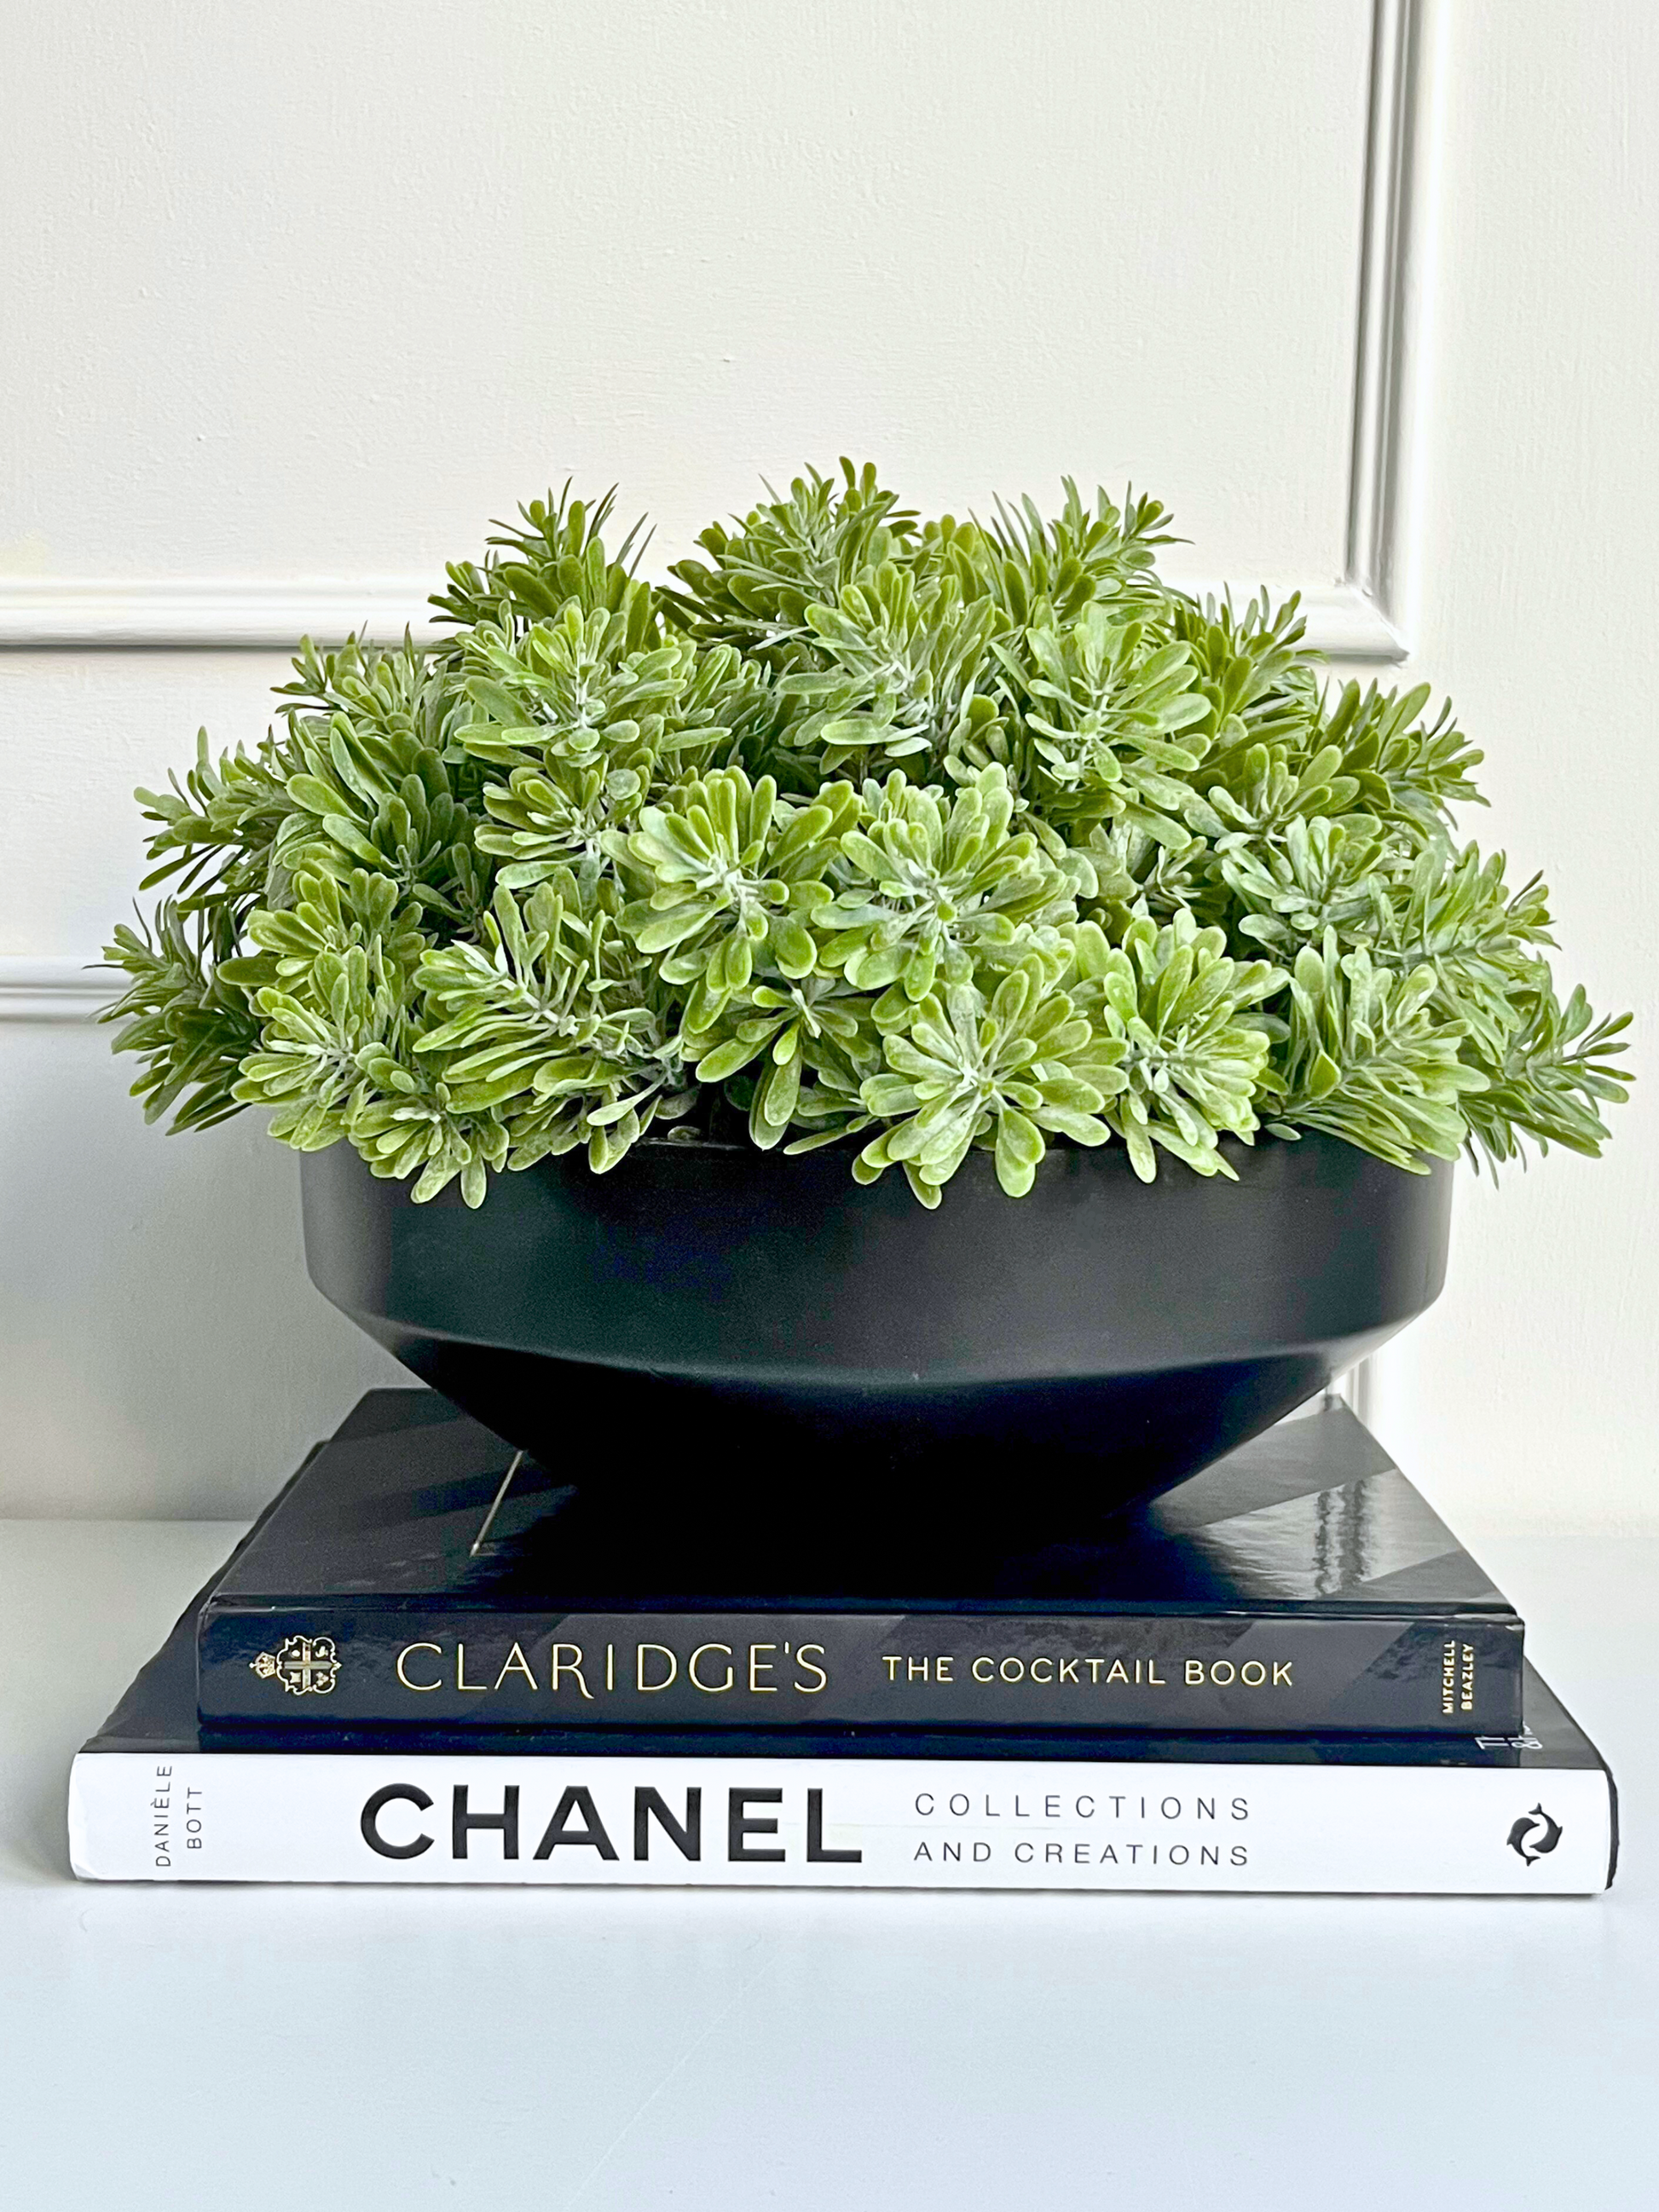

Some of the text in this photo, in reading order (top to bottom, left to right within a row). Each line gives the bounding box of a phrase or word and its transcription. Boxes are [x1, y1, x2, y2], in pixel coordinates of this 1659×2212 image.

[396, 1641, 1293, 1700] CLARIDGE'S THE COCKTAIL BOOK
[1442, 1640, 1455, 1714] MITCHELL
[1460, 1643, 1474, 1710] BEAZLEY
[150, 1766, 172, 1867] DANIÈLE
[186, 1787, 202, 1850] BOTT
[360, 1783, 863, 1863] CHANEL
[915, 1793, 1250, 1821] COLLECTIONS
[913, 1841, 1249, 1867] AND CREATIONS
